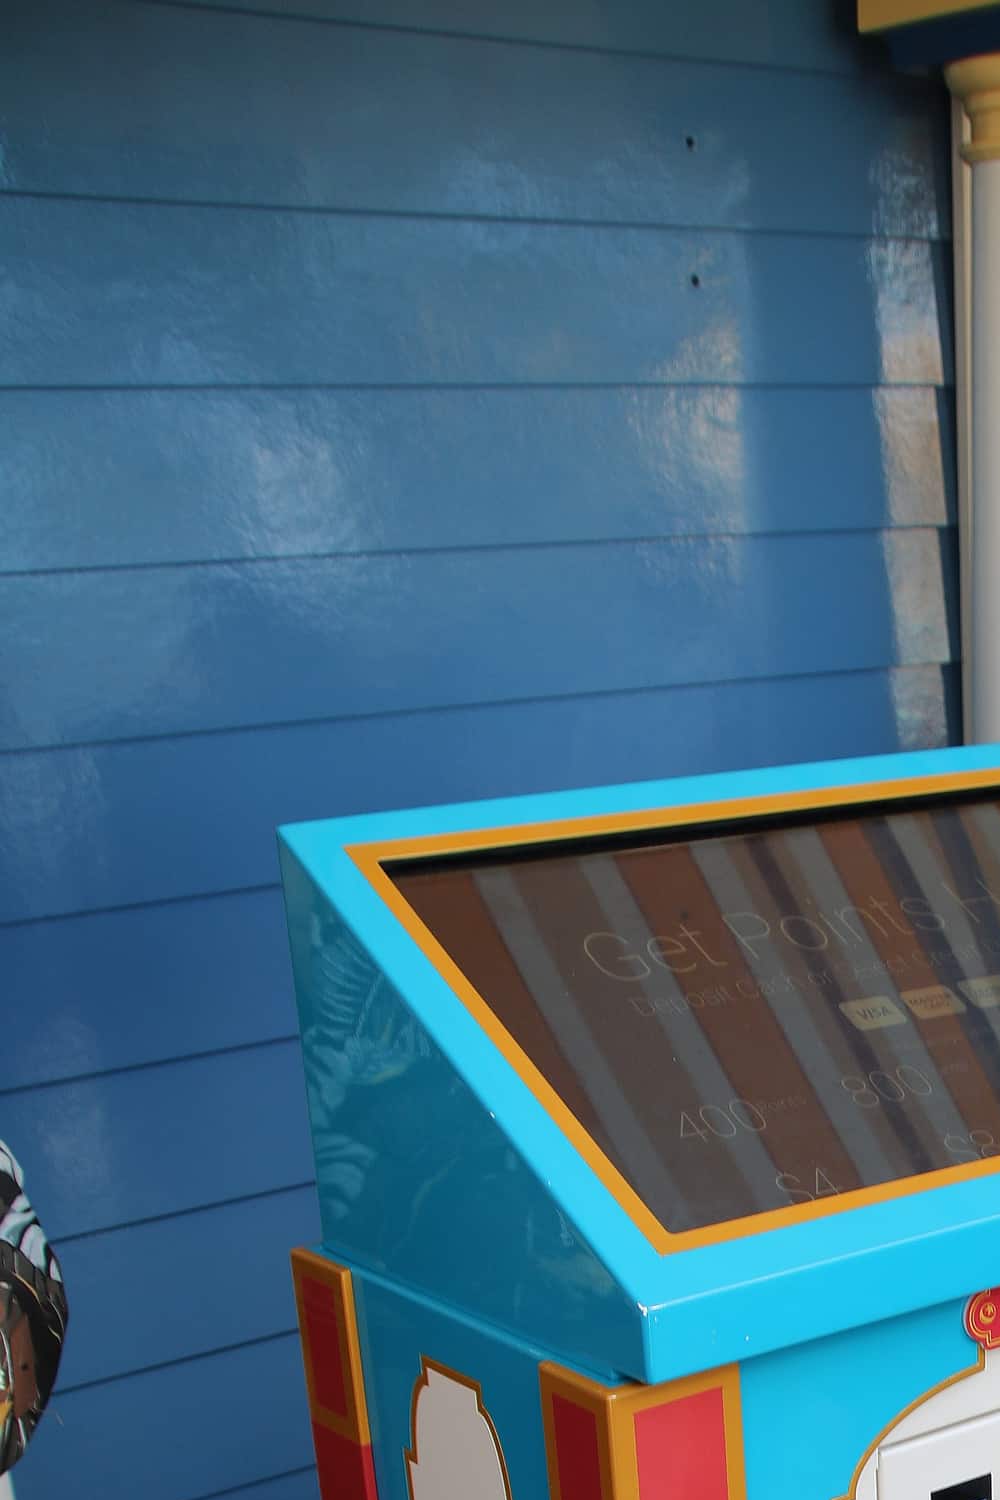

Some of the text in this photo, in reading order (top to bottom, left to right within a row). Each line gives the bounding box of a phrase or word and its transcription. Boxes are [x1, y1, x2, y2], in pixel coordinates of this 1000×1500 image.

[583, 921, 728, 982] Get
[721, 894, 946, 962] Points
[856, 1007, 890, 1021] VISA
[841, 1065, 933, 1109] 800
[680, 1098, 767, 1143] 400
